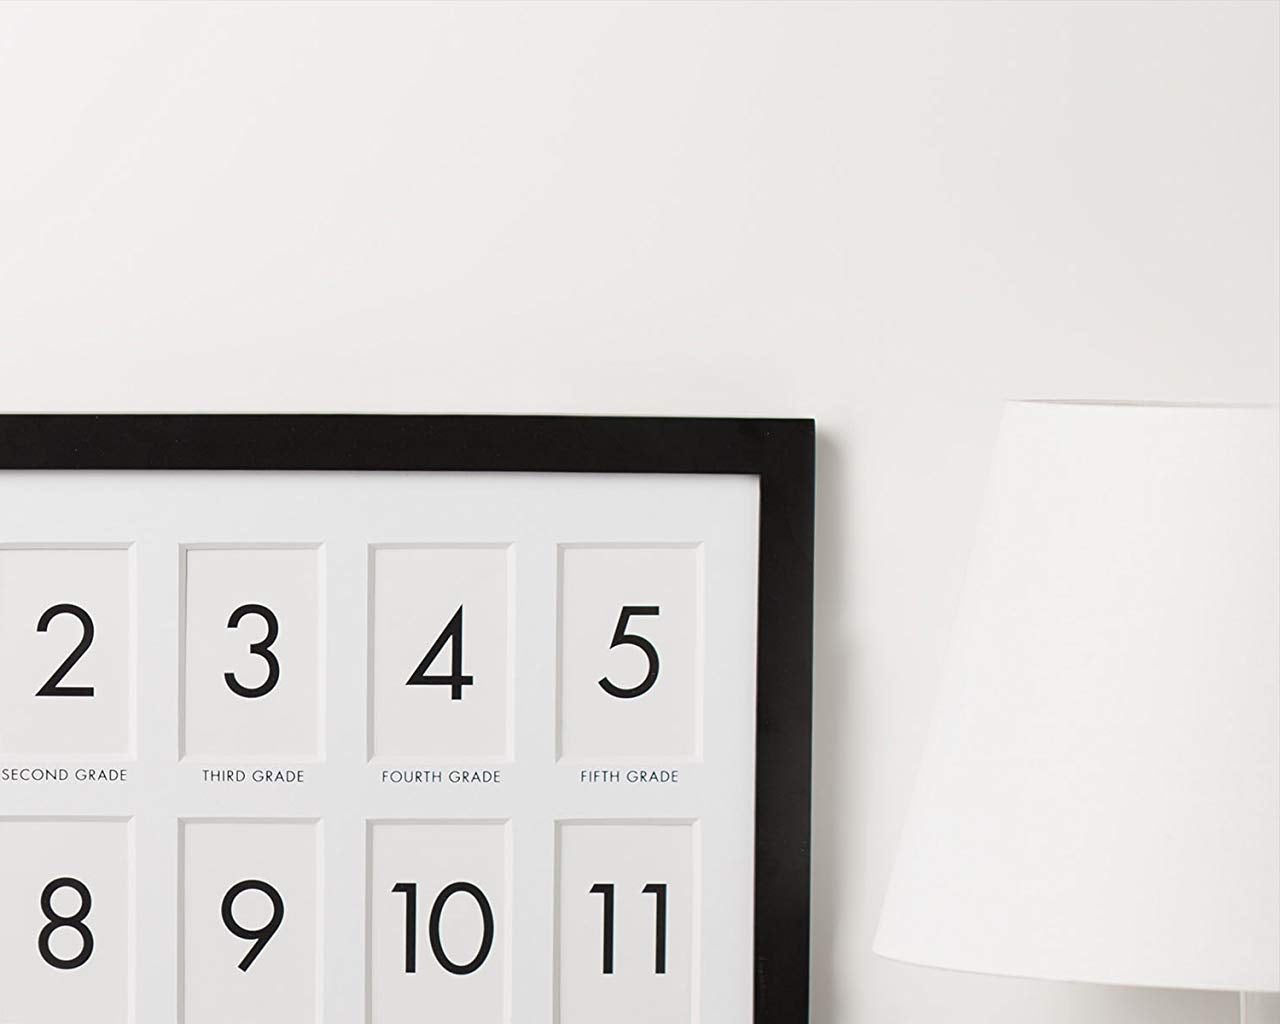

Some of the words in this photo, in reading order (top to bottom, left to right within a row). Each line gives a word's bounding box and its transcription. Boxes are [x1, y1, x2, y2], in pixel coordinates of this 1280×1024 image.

[34, 603, 95, 697] 2
[223, 603, 280, 699] 3
[405, 604, 474, 701] 4
[597, 605, 660, 699] 5
[1, 768, 69, 781] SECOND
[74, 768, 127, 782] GRADE
[202, 769, 246, 783] THIRD
[251, 769, 304, 783] GRADE
[382, 770, 442, 784] FOURTH
[448, 770, 500, 784] GRADE
[580, 770, 620, 783] FIFTH
[626, 770, 679, 783] GRADE
[37, 876, 95, 970] 8
[220, 879, 285, 973] 9
[391, 882, 495, 976] 10
[589, 883, 668, 975] 11
